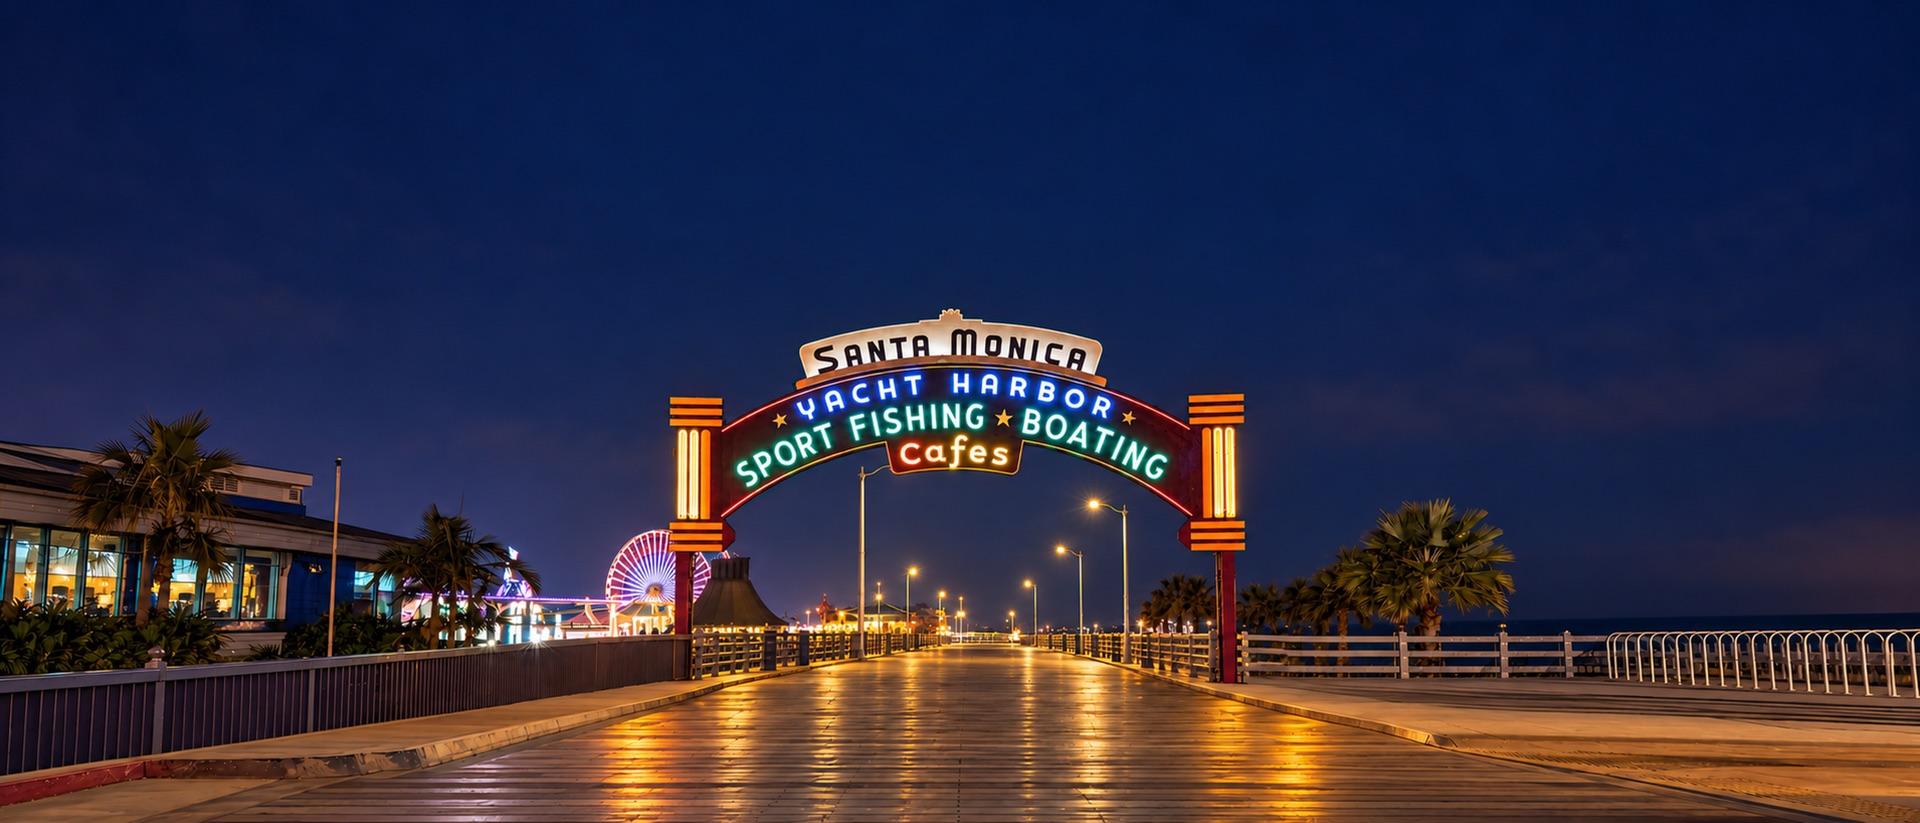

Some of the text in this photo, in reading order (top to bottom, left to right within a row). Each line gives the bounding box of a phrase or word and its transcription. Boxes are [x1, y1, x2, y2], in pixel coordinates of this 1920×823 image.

[813, 329, 1086, 373] SANTA MONICA
[796, 373, 1112, 420] YACHT HARBOR
[736, 402, 1169, 487] SPORT FISHING BOATING
[899, 434, 1009, 469] Cafes
